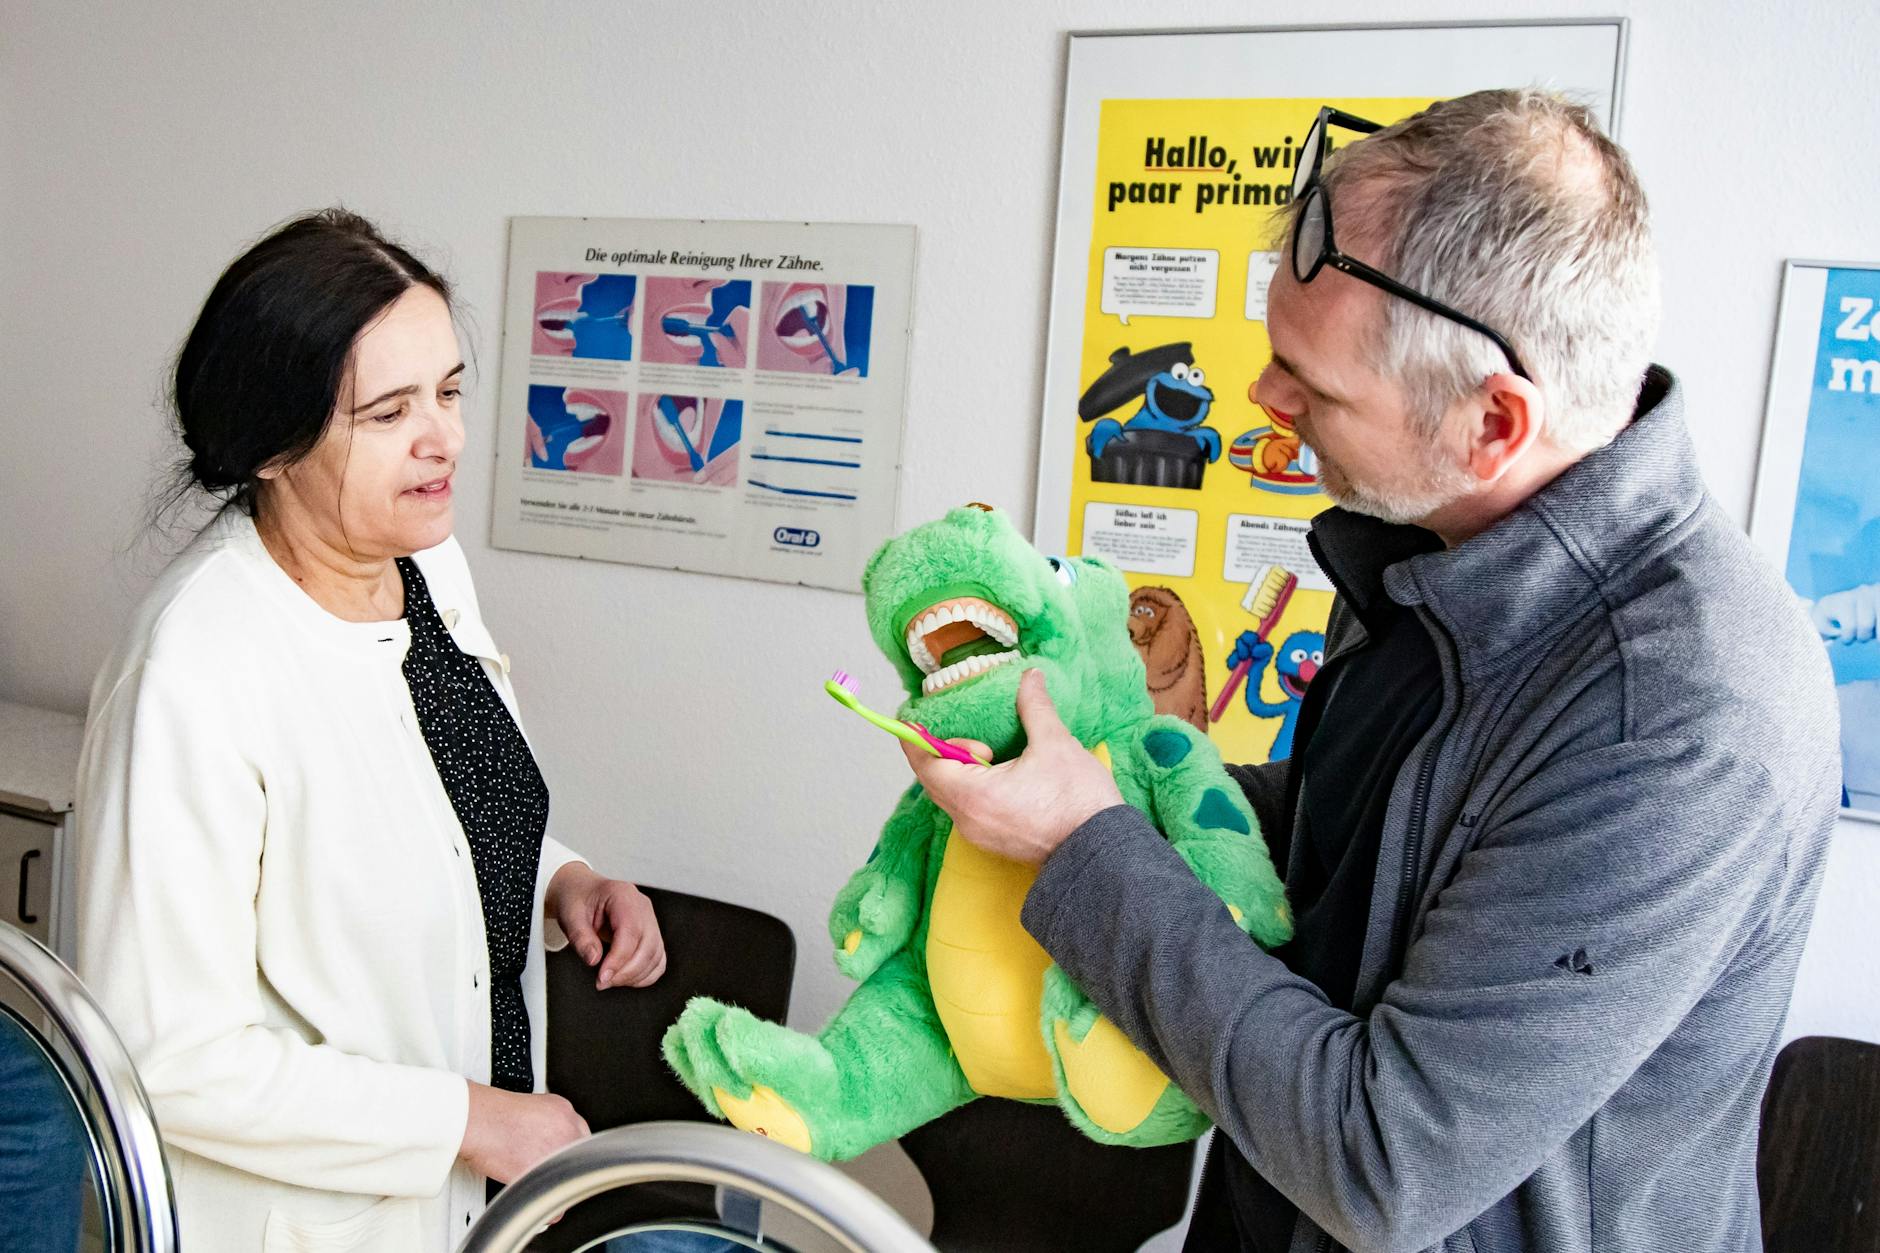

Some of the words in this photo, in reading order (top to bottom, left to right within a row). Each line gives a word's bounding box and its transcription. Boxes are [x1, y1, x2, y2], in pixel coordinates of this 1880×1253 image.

[1145, 136, 1237, 174] Hallo,
[1108, 181, 1182, 212] paar
[1195, 173, 1292, 214] prima
[585, 248, 607, 262] Die
[611, 249, 667, 267] optimale
[670, 250, 736, 271] Reinigung
[740, 254, 774, 269] Ihrer
[776, 254, 824, 272] Zähne.
[1129, 262, 1148, 271] nicht
[1151, 264, 1191, 274] vergessen
[1151, 253, 1176, 262] Zähne
[1179, 255, 1207, 264] putzen
[776, 528, 817, 546] Oral-B
